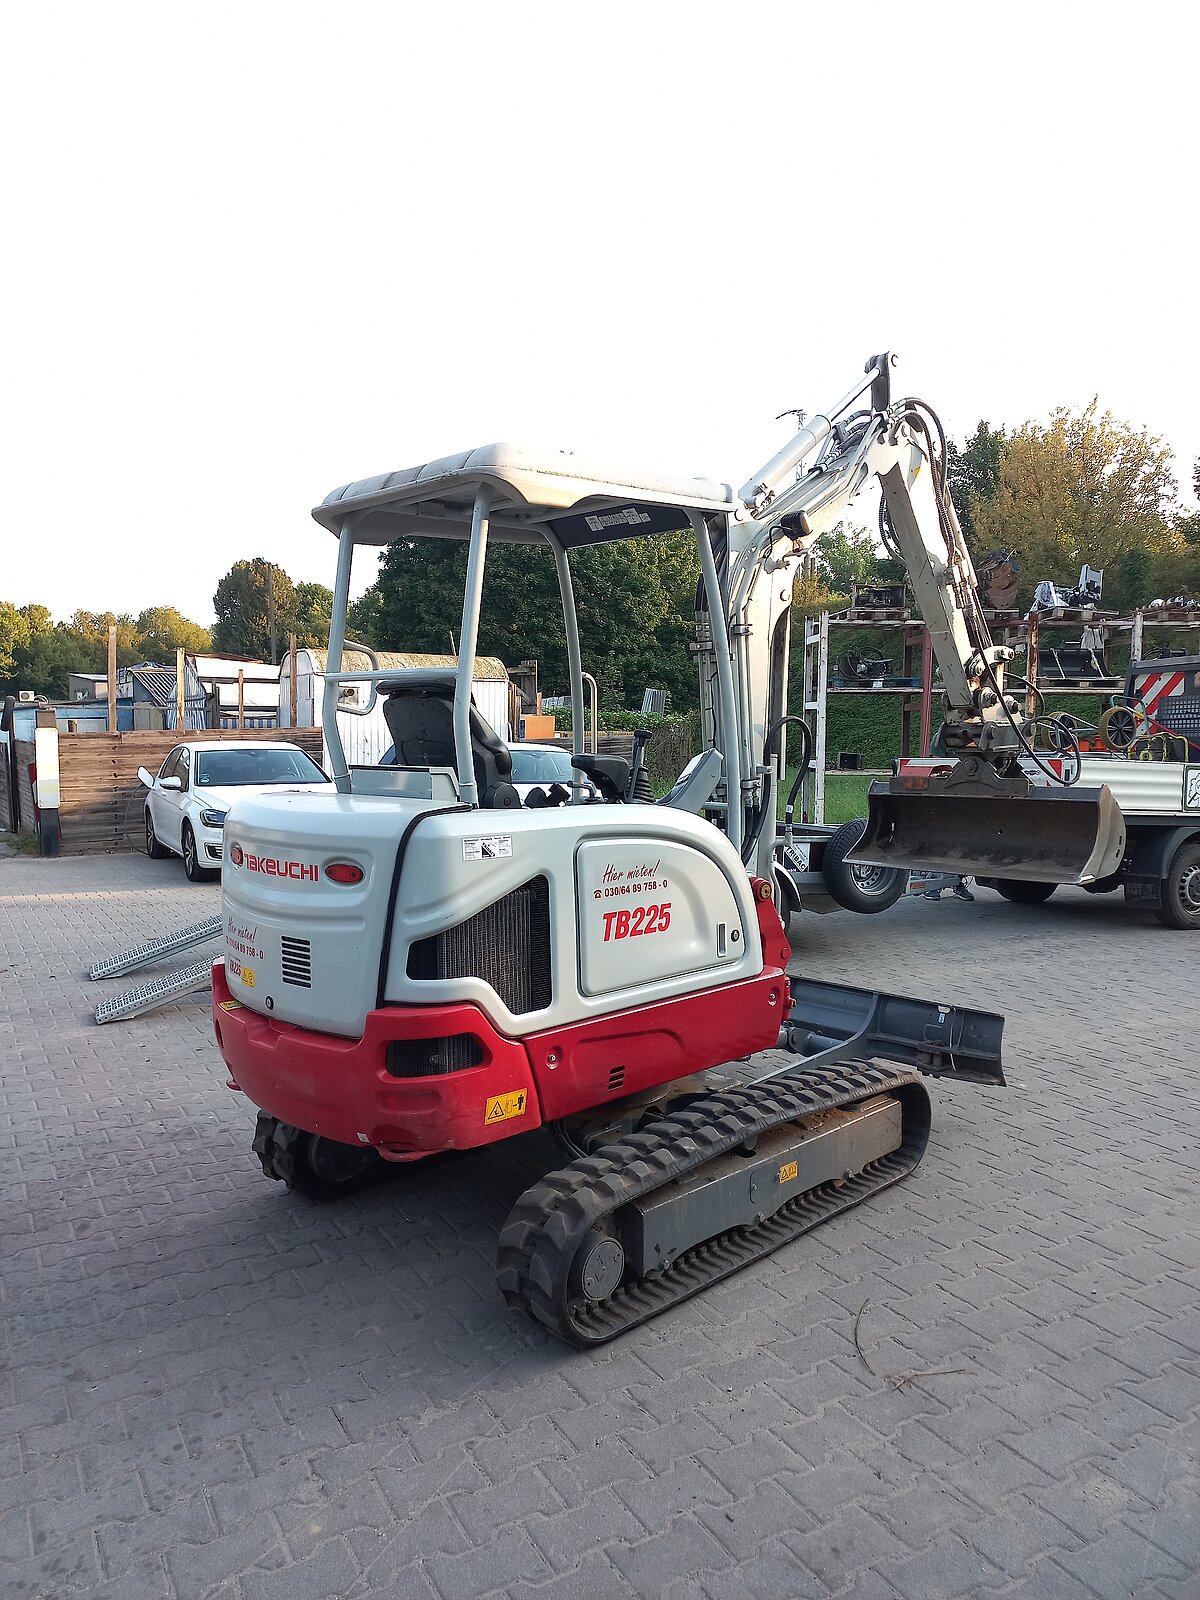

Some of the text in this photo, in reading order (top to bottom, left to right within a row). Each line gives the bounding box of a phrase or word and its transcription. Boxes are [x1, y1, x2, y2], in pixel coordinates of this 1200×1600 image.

[244, 853, 319, 882] TAKEUCHI
[602, 859, 661, 884] Hier mieten!
[604, 885, 631, 898] 030/64
[632, 883, 642, 893] 89
[643, 881, 657, 891] 758
[662, 879, 668, 888] 0
[602, 902, 672, 942] TB225
